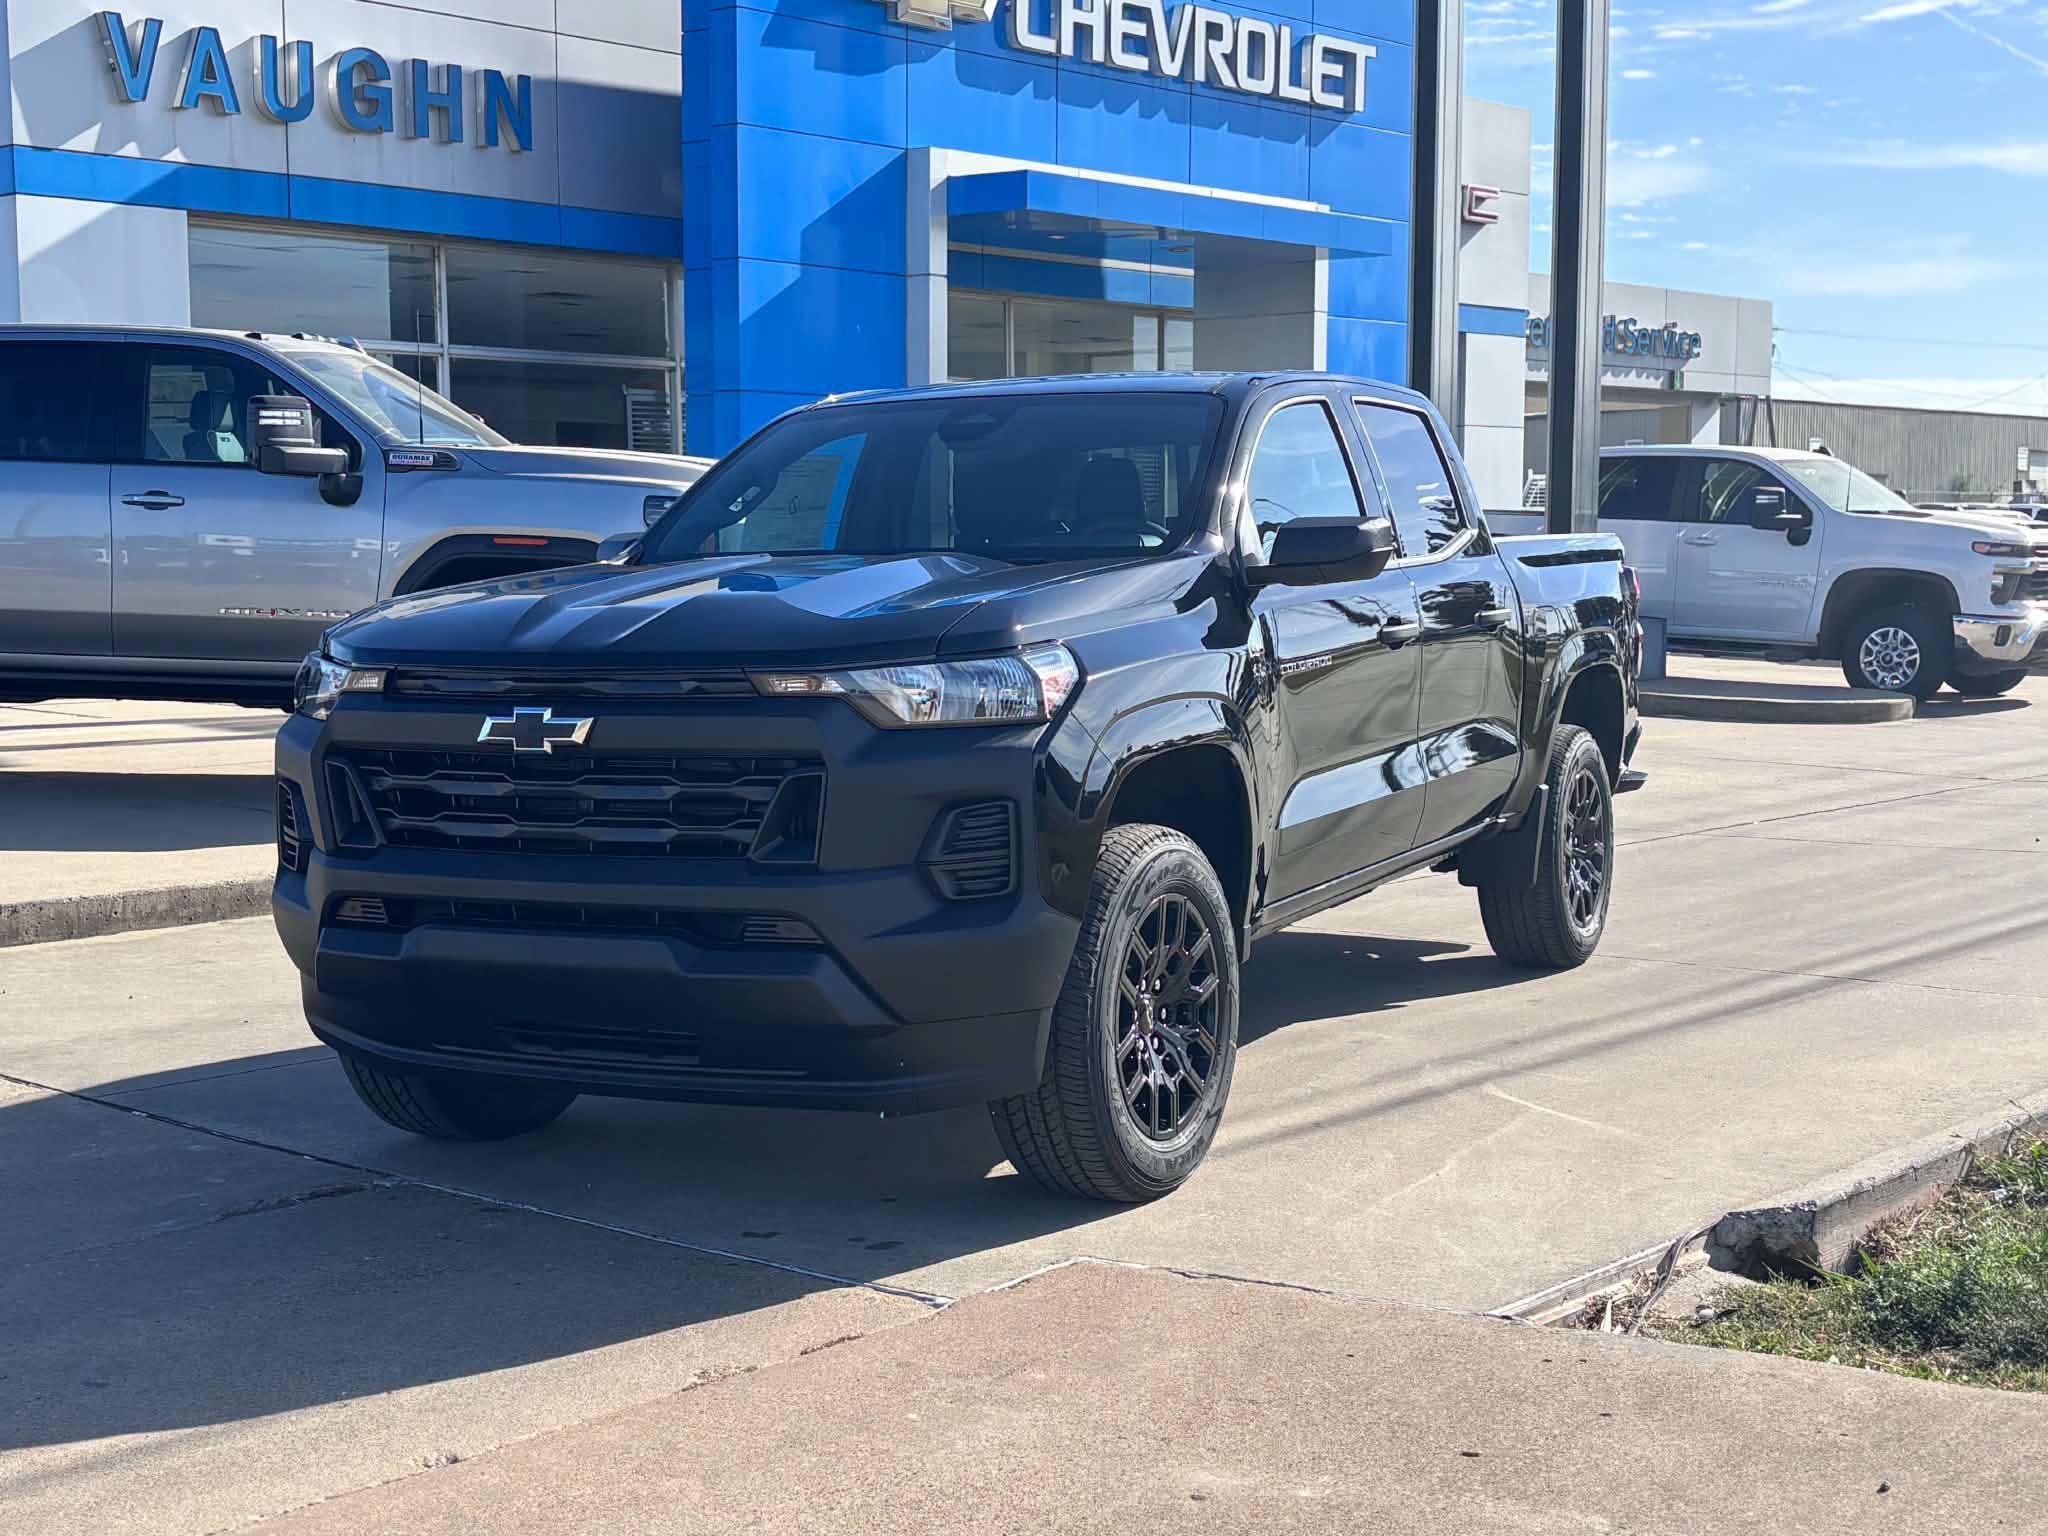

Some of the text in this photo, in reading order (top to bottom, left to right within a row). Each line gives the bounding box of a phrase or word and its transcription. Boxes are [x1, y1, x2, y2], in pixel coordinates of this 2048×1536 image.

[97, 11, 533, 152] VAUGHN
[1010, 0, 1377, 113] CHEVROLET
[1622, 317, 1702, 359] Service
[1280, 656, 1332, 674] COLORADO
